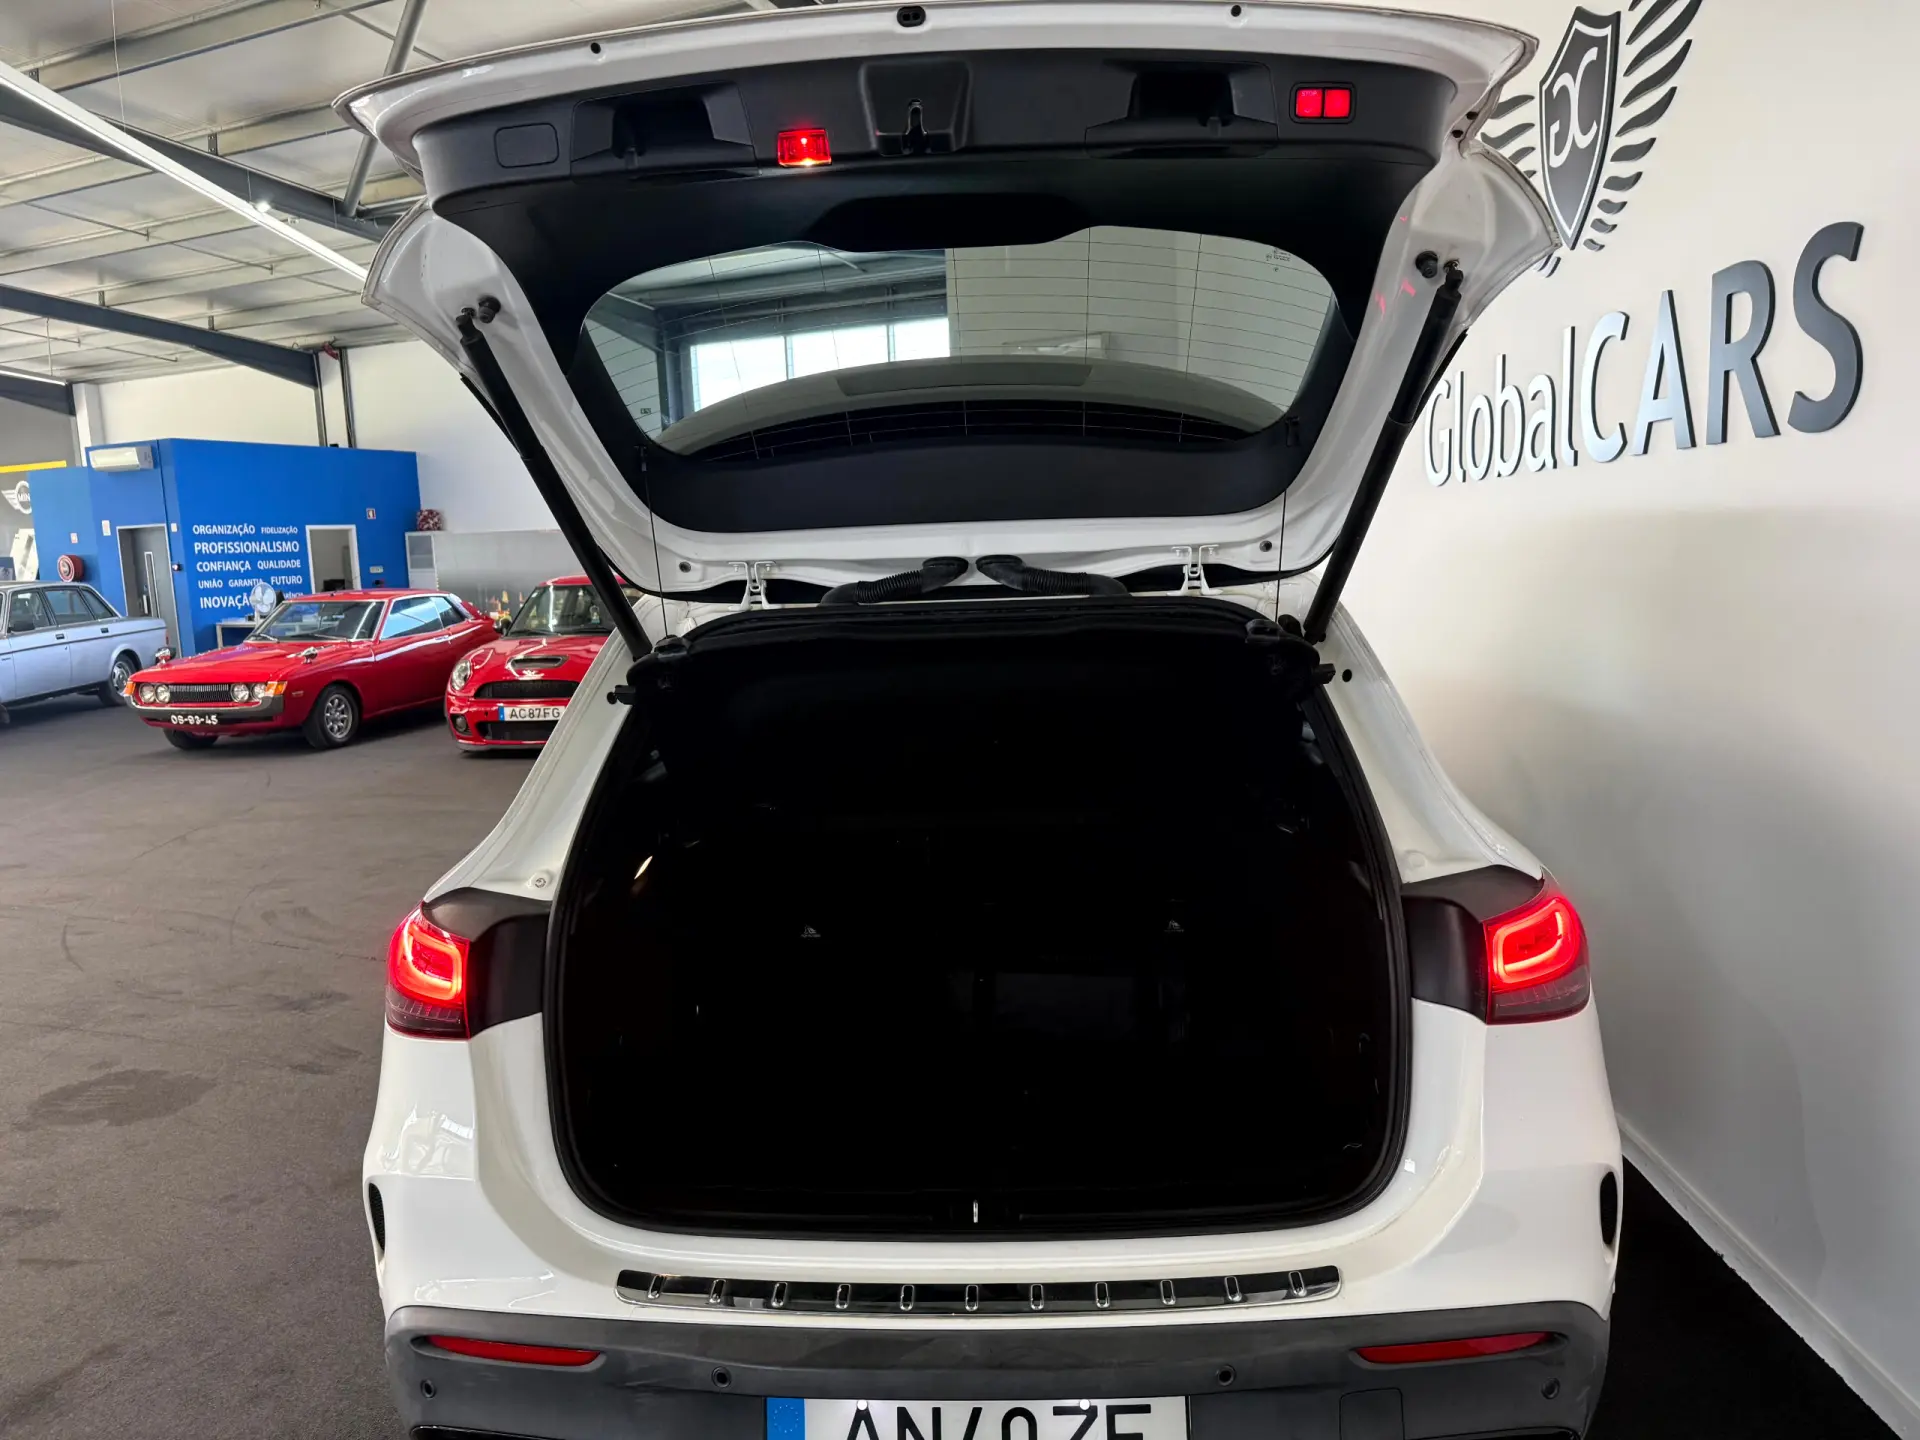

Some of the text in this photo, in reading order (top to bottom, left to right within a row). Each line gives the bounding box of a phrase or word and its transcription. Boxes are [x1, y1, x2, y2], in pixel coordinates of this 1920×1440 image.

[1424, 221, 1864, 487] GlobalCARS
[192, 523, 298, 537] ORGANIZAÇÃO FIDELIZAÇÃO
[194, 541, 300, 554] PROFISSIONALISMO
[196, 559, 301, 573] CONFIANÇA QUALIDADE
[198, 578, 224, 589] UNIÃO
[270, 575, 303, 586] FUTURO
[200, 592, 251, 610] INOVAÇÃ
